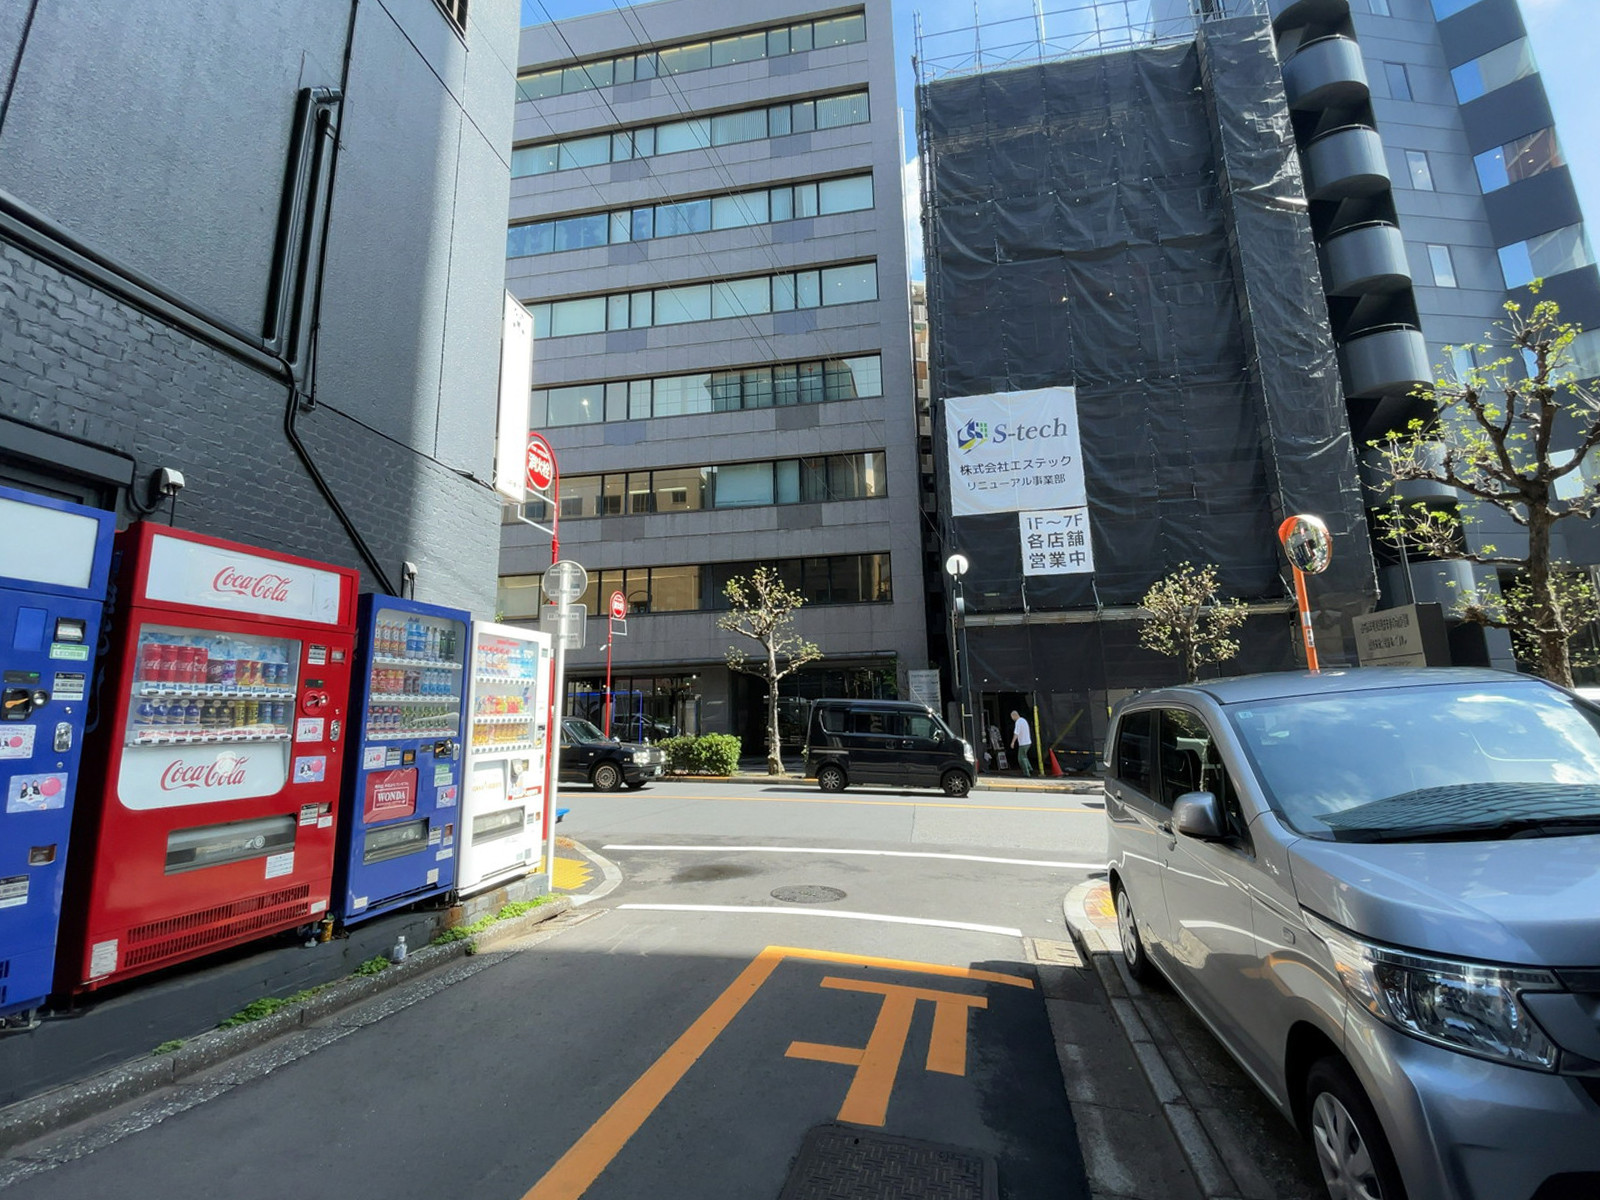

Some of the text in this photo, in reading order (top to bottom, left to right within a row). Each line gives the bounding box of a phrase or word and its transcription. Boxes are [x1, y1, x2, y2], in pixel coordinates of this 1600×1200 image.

[992, 417, 1067, 444] S-tech
[960, 455, 1072, 476] 株式会社エステック
[967, 474, 1066, 491] リニューアル事業部
[1027, 531, 1084, 549] 各店舗
[1029, 550, 1086, 569] 営業中
[377, 790, 406, 802] WONDA
